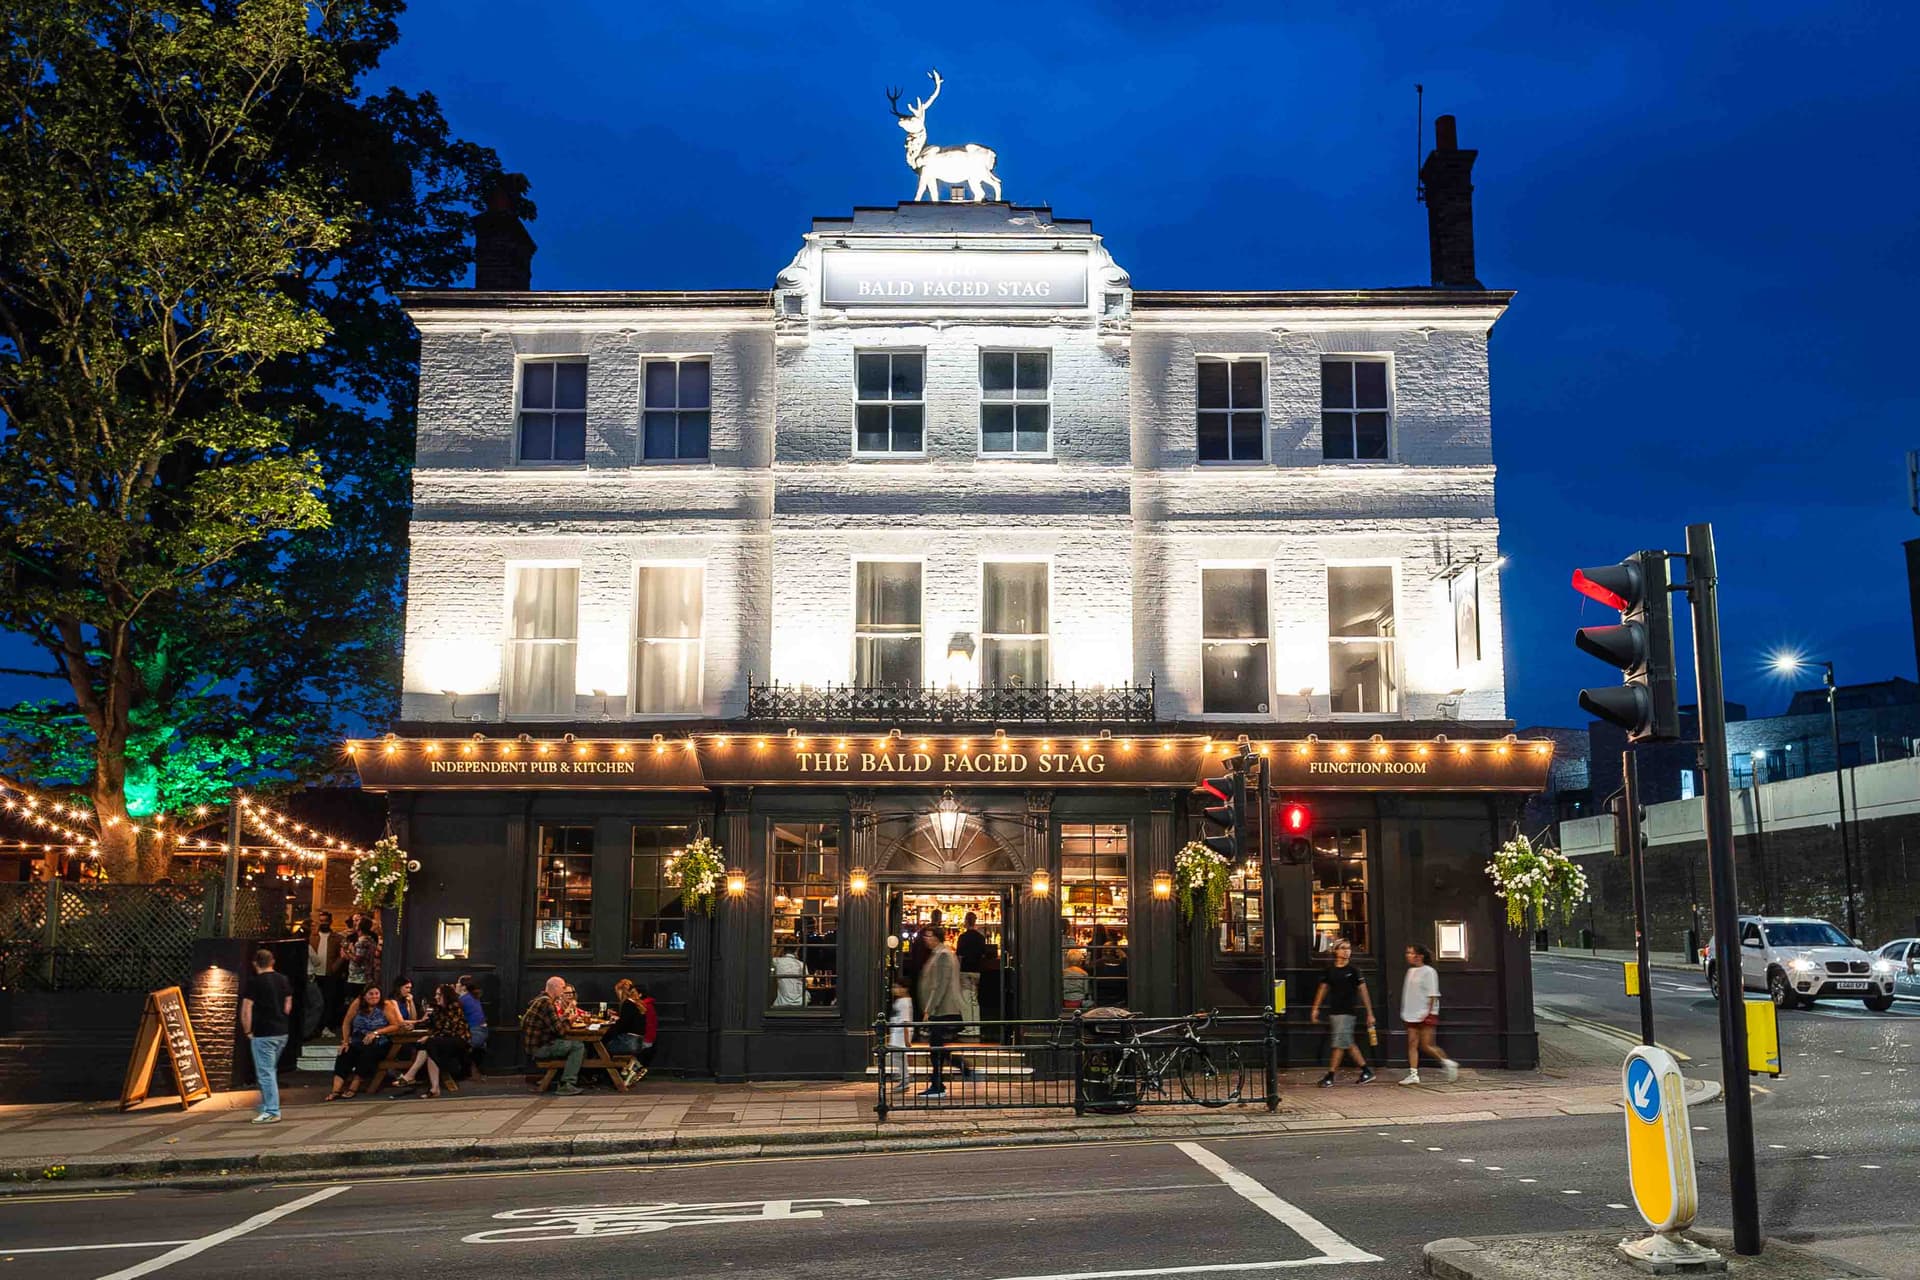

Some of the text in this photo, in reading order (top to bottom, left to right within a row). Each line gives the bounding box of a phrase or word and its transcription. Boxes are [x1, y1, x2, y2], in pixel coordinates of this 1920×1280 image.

[858, 281, 1051, 297] BALD FACED STAG
[431, 761, 635, 773] INDEPENDENT PUB & KITCHEN
[796, 753, 1106, 773] THE BALD FACED STAG
[1309, 762, 1427, 774] FUNCTION ROOM
